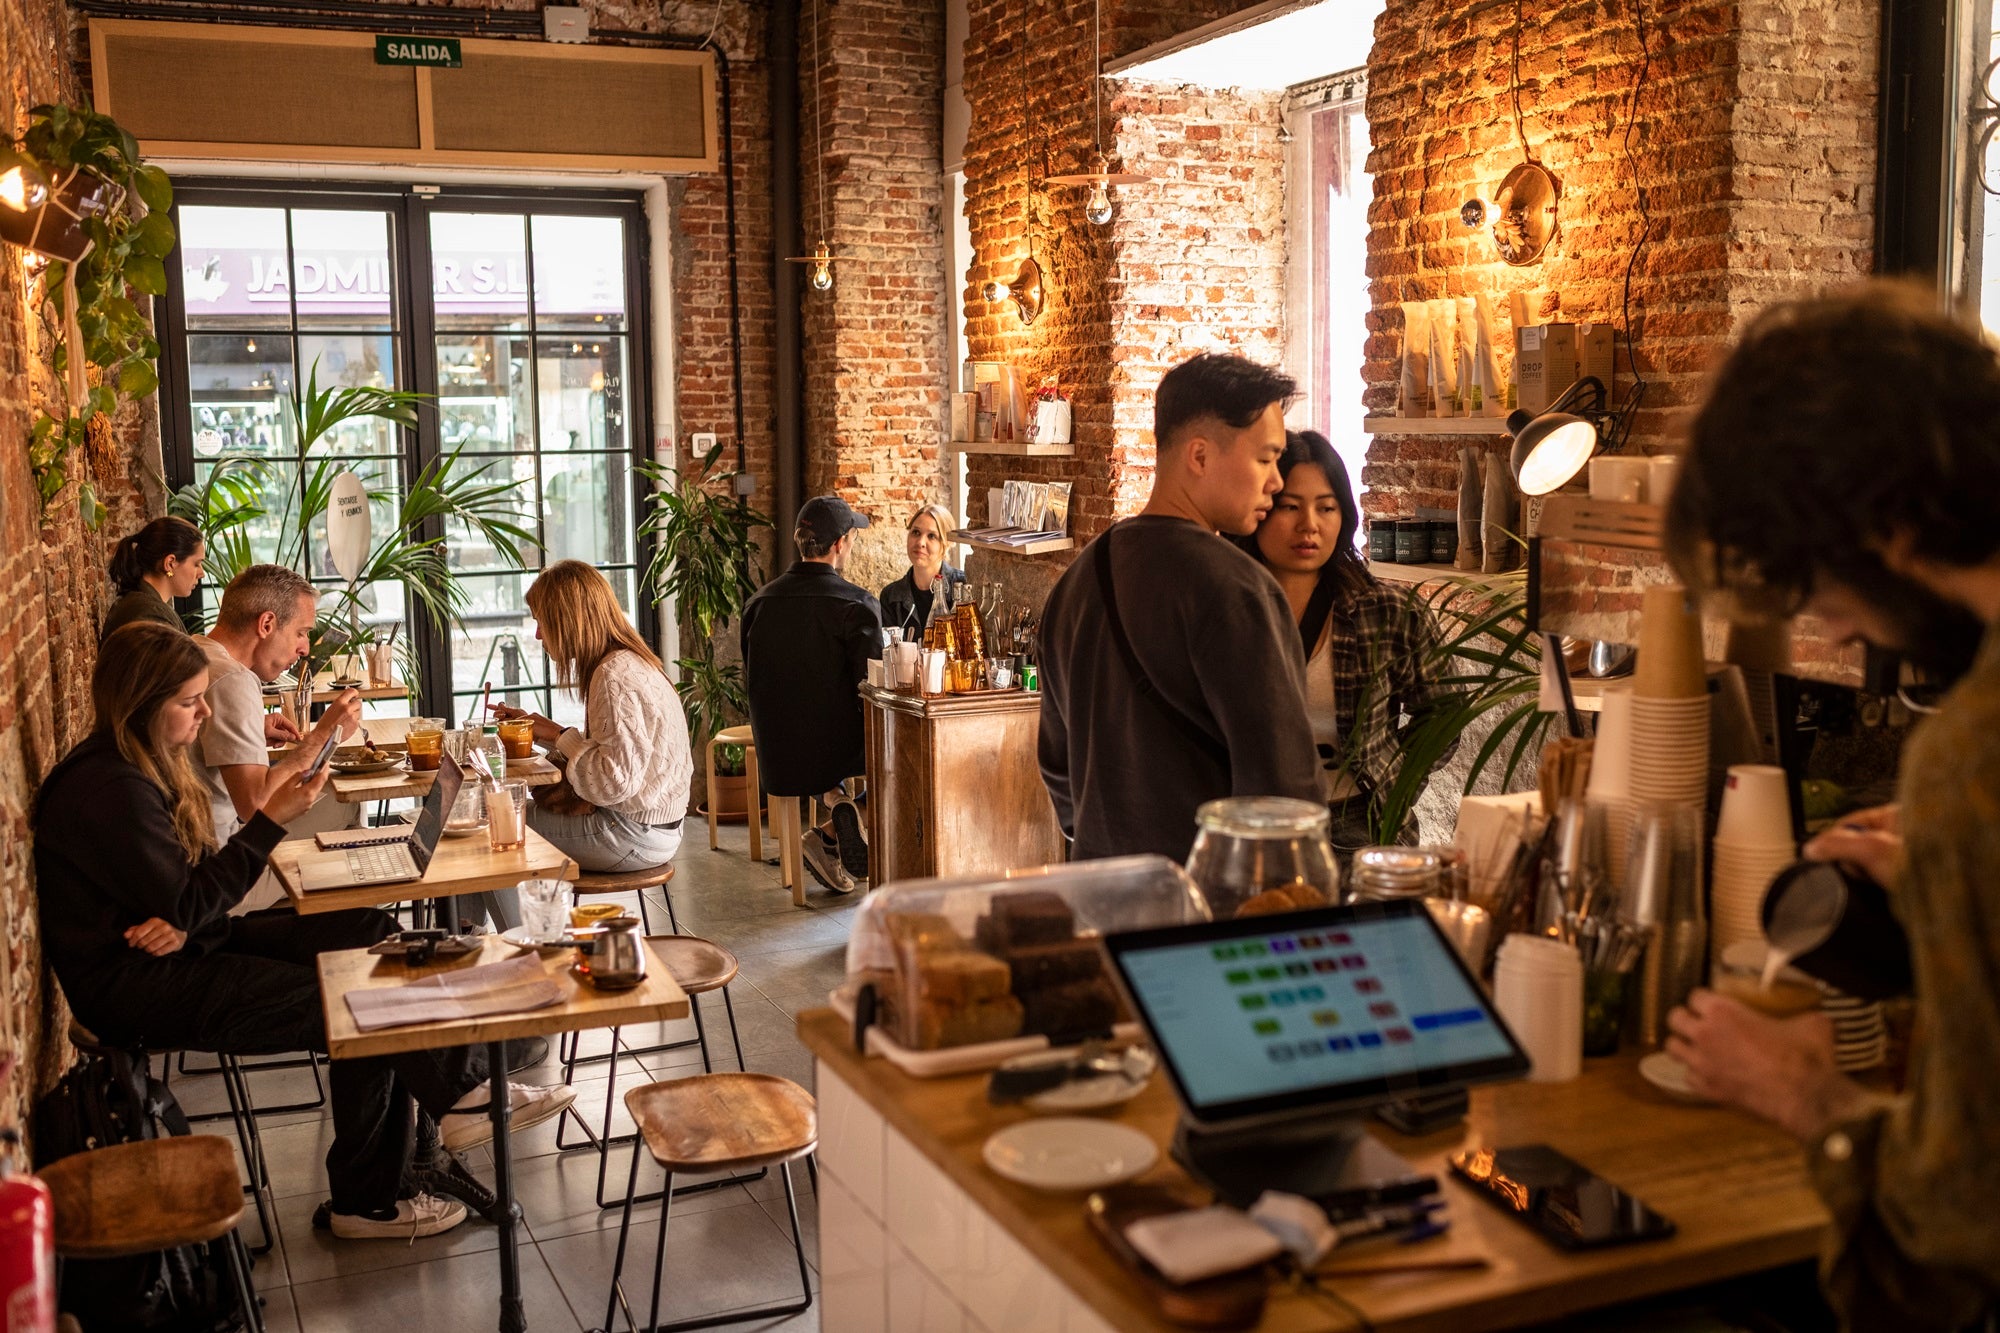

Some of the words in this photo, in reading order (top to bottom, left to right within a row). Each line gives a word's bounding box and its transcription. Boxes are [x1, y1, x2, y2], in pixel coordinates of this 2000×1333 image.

[387, 43, 451, 60] SALIDA
[247, 256, 463, 294] JADMIR
[1522, 362, 1543, 372] DROP
